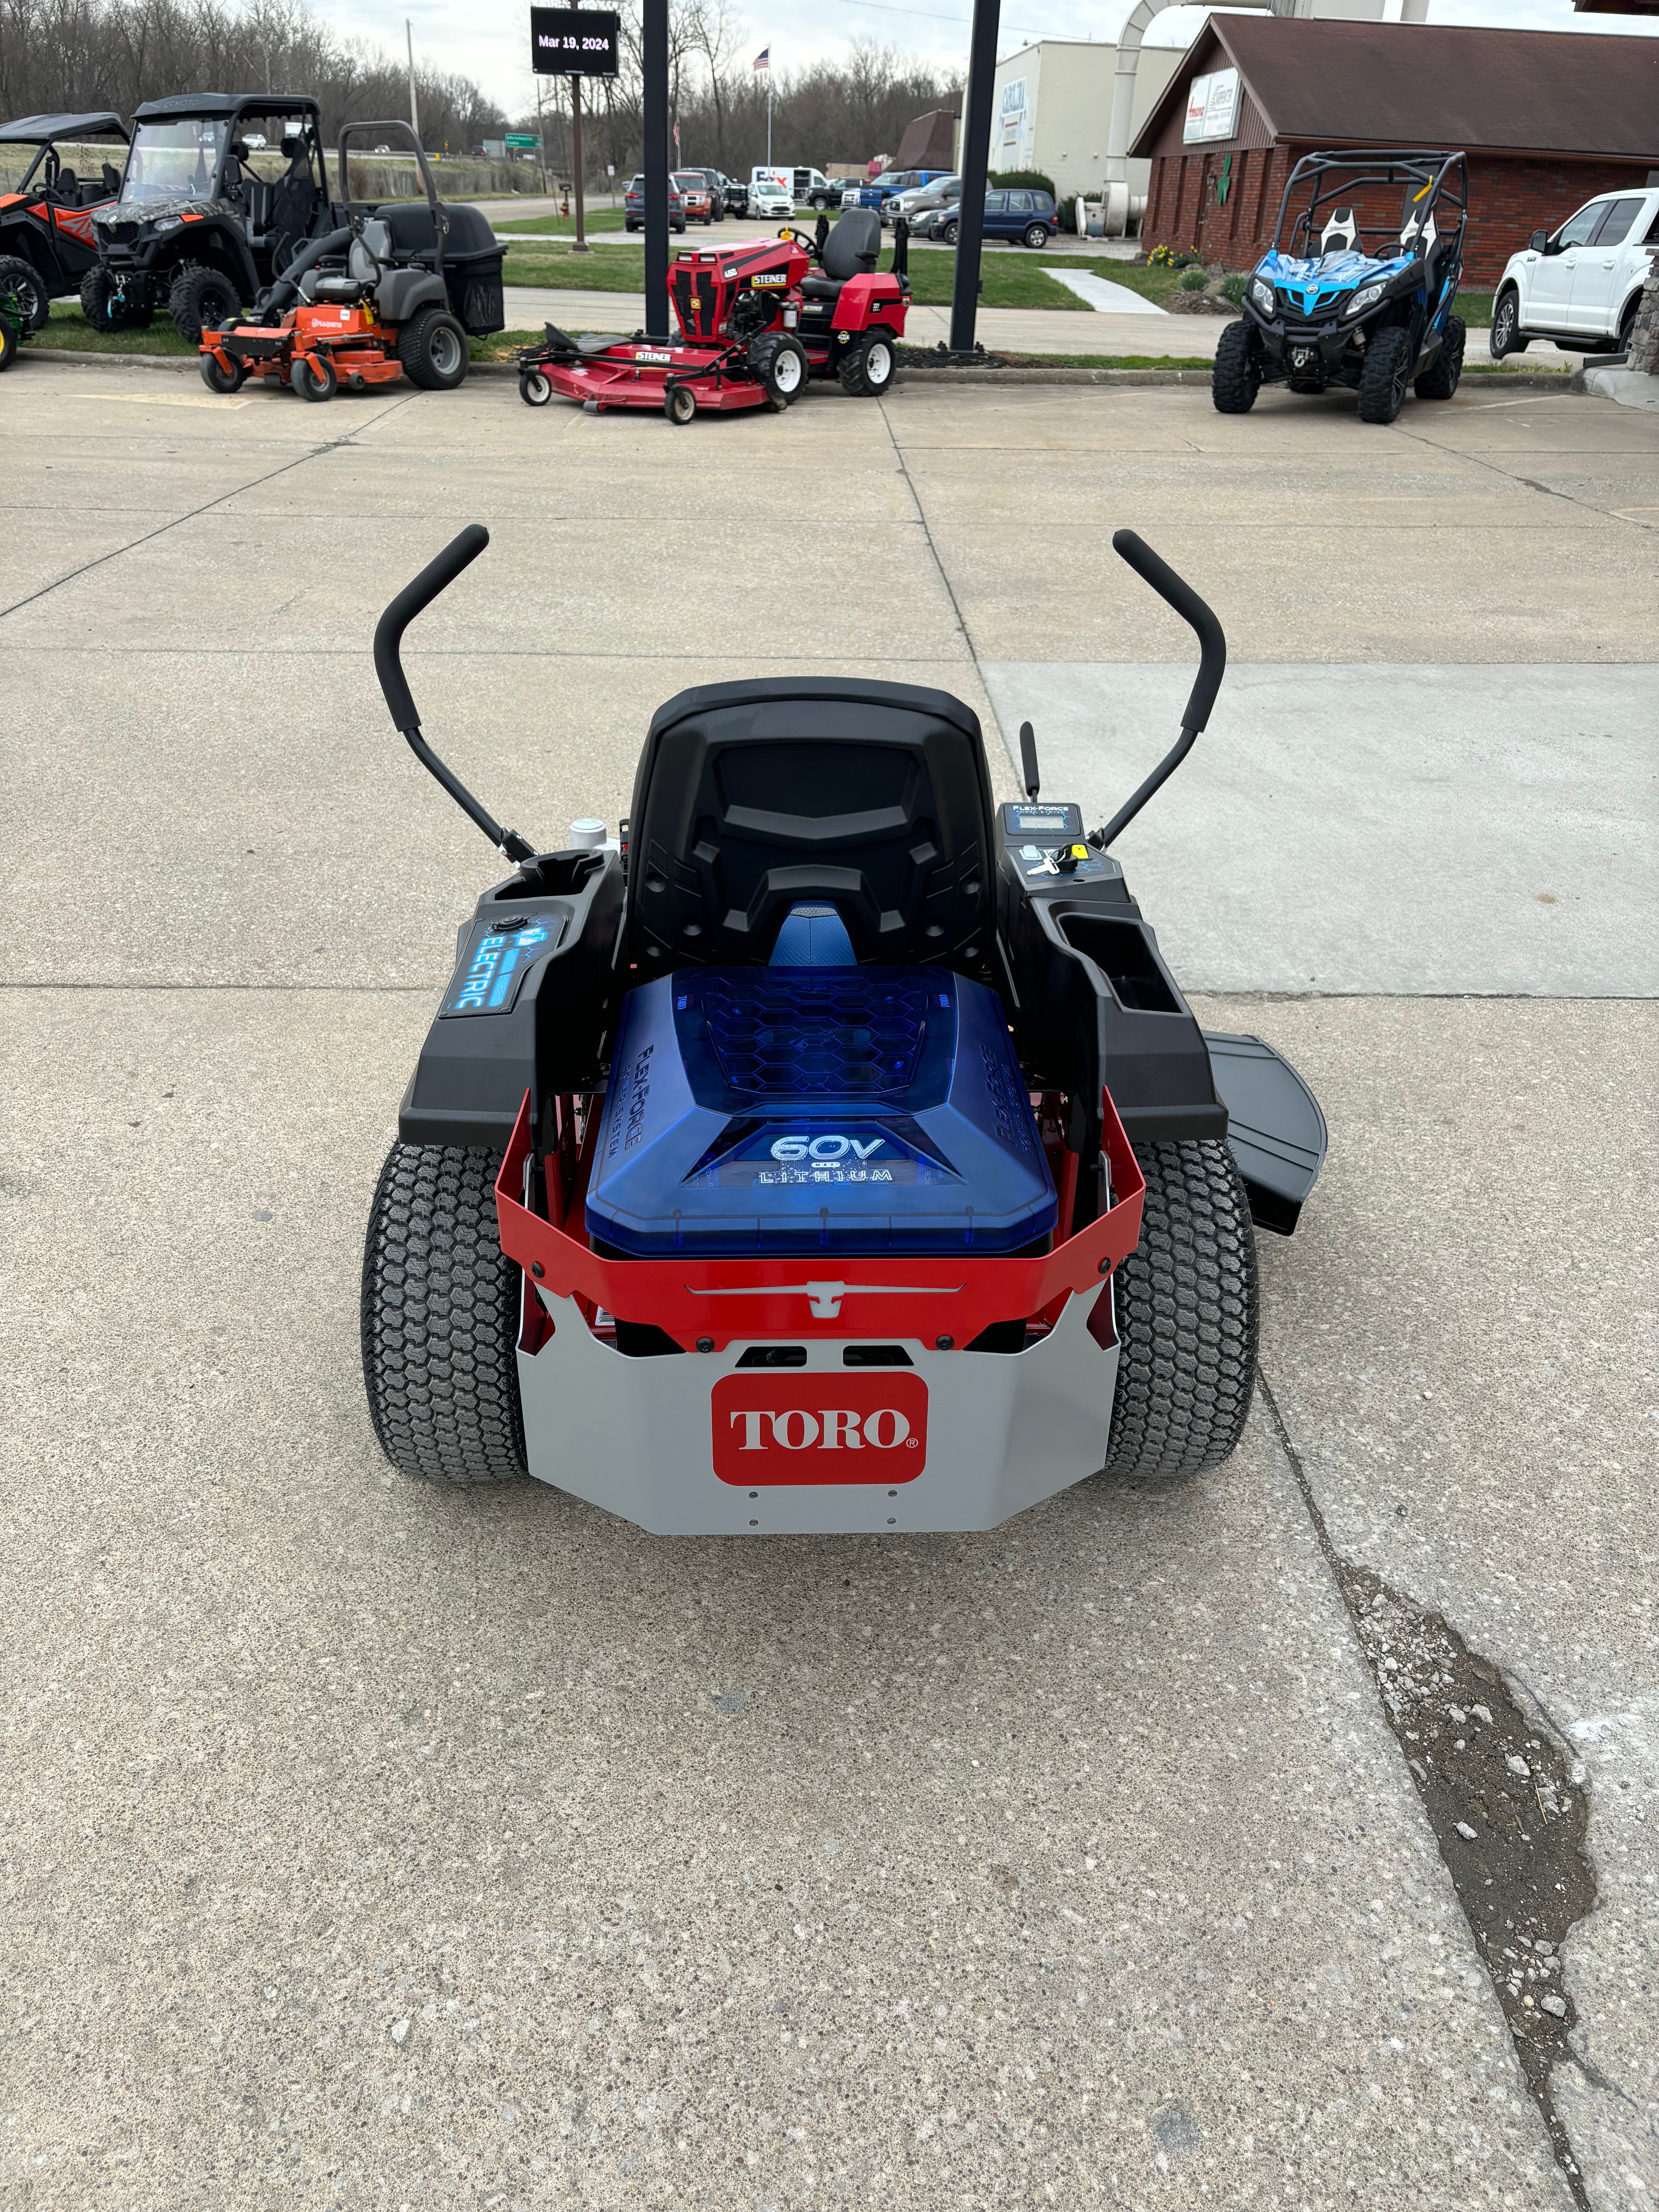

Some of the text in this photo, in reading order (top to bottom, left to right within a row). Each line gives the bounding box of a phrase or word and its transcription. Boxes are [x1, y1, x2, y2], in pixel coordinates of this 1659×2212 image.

[539, 34, 609, 50] Mar 19, 2024
[754, 274, 787, 283] STEINER
[638, 352, 672, 361] STEINER
[455, 936, 506, 1009] ELECTRIC
[678, 995, 687, 1010] TORO
[939, 995, 949, 1007] TORO
[625, 1044, 654, 1152] FLEX-FORCE
[608, 1107, 623, 1159] SYSTEM
[760, 1170, 892, 1183] LITHIUM
[730, 1409, 910, 1449] TORO
